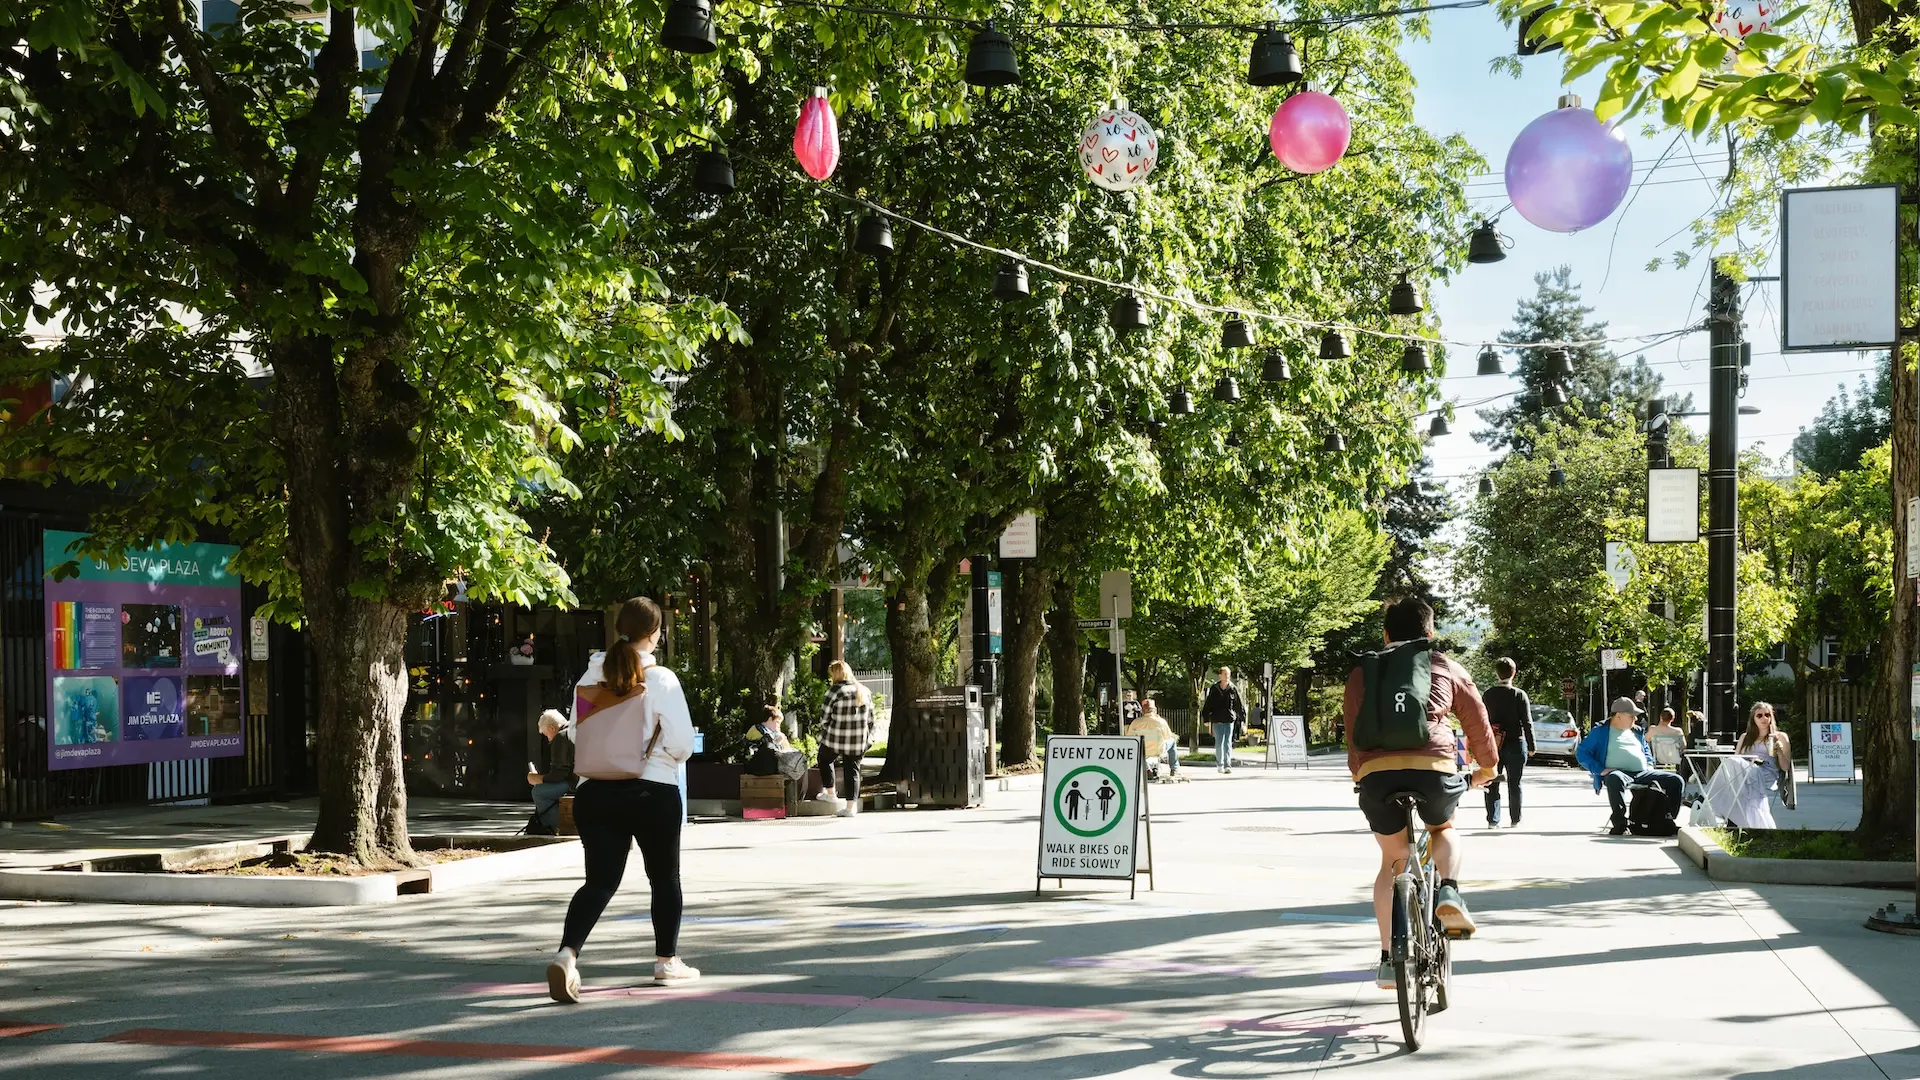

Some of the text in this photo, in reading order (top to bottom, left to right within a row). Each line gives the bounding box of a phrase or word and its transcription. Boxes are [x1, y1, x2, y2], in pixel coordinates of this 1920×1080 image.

[121, 557, 156, 572] DEVA
[160, 559, 200, 575] PLAZA
[210, 627, 227, 636] ABOUT
[196, 640, 228, 652] COMMUNITY
[128, 715, 139, 725] JIM
[159, 714, 179, 724] PLAZA
[190, 738, 240, 748] JIMDEVAPLAZA.CA
[55, 748, 101, 759] @jimdevaplaza
[1052, 747, 1134, 760] EVENT ZONE
[1046, 844, 1129, 855] WALK BIKES OR
[1052, 857, 1120, 869] RIDE SLOWLY
